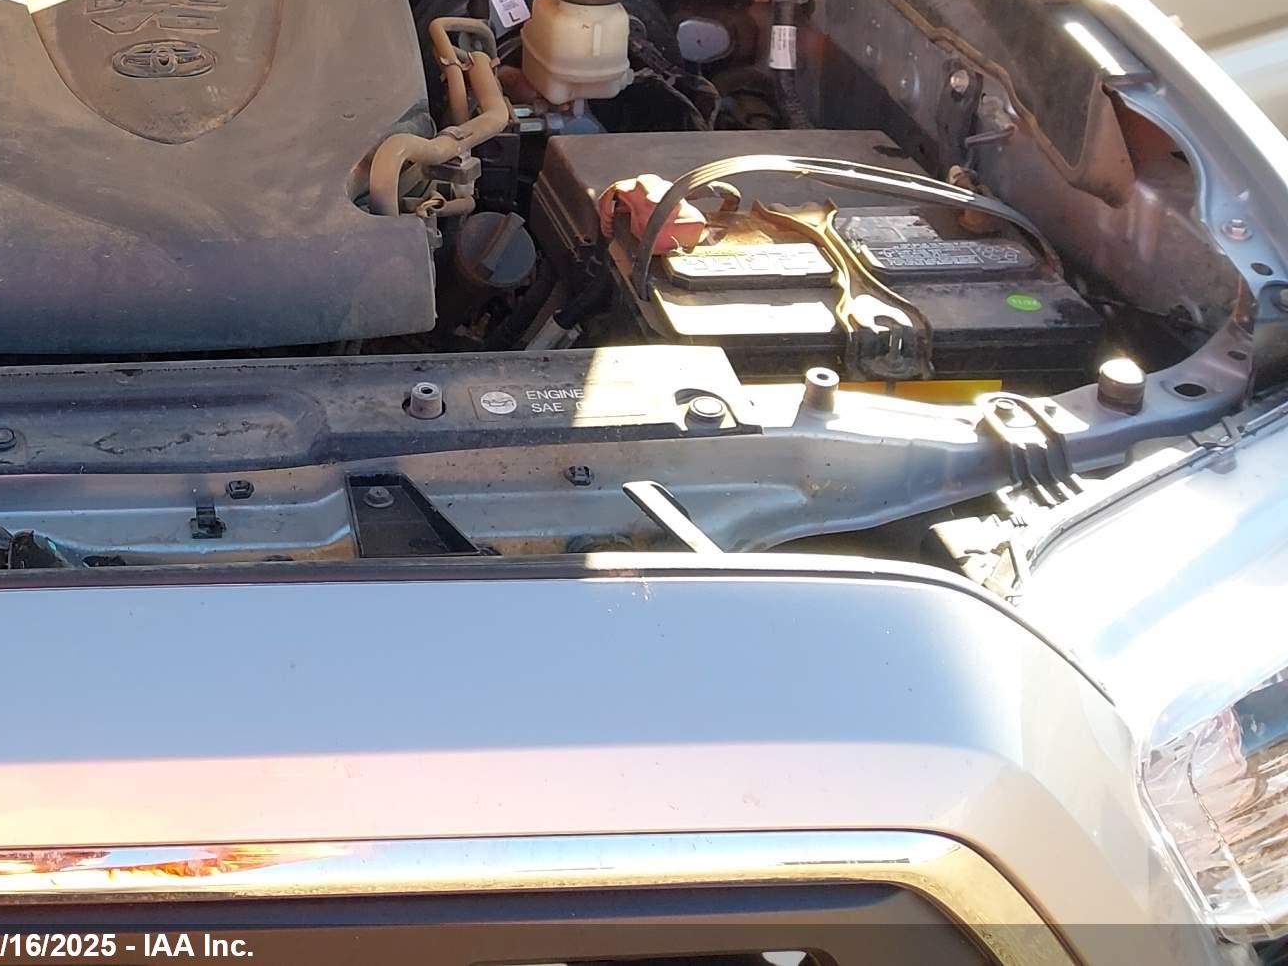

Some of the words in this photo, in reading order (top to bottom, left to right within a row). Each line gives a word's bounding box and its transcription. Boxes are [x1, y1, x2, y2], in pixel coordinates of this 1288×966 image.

[508, 11, 521, 23] L
[525, 389, 585, 401] ENGINE
[531, 402, 565, 413] SAE
